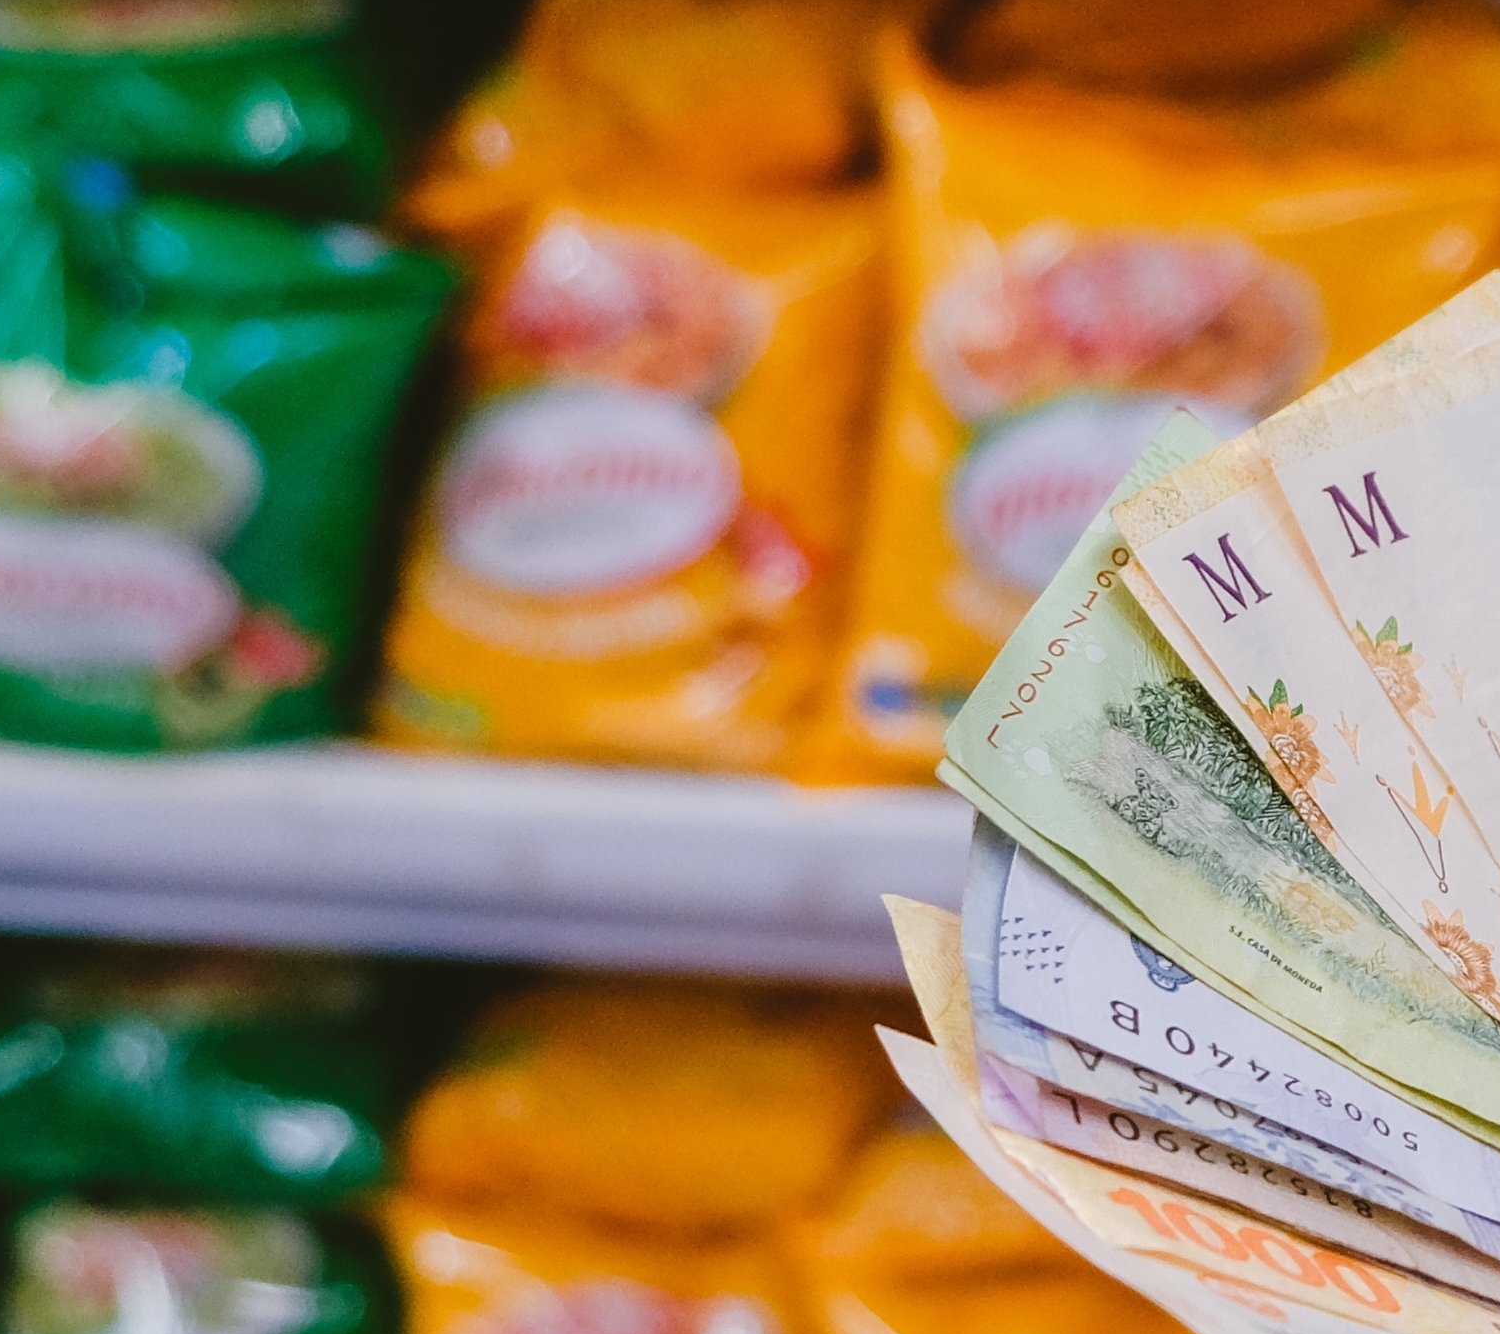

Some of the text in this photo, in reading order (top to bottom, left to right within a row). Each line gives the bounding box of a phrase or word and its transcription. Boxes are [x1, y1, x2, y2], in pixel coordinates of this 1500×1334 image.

[1322, 471, 1410, 558] M
[1182, 532, 1273, 623] M
[1247, 938, 1270, 957] CASA
[1270, 954, 1283, 966] DE
[1282, 965, 1323, 993] MONEDA
[1106, 1187, 1401, 1314] 1000
